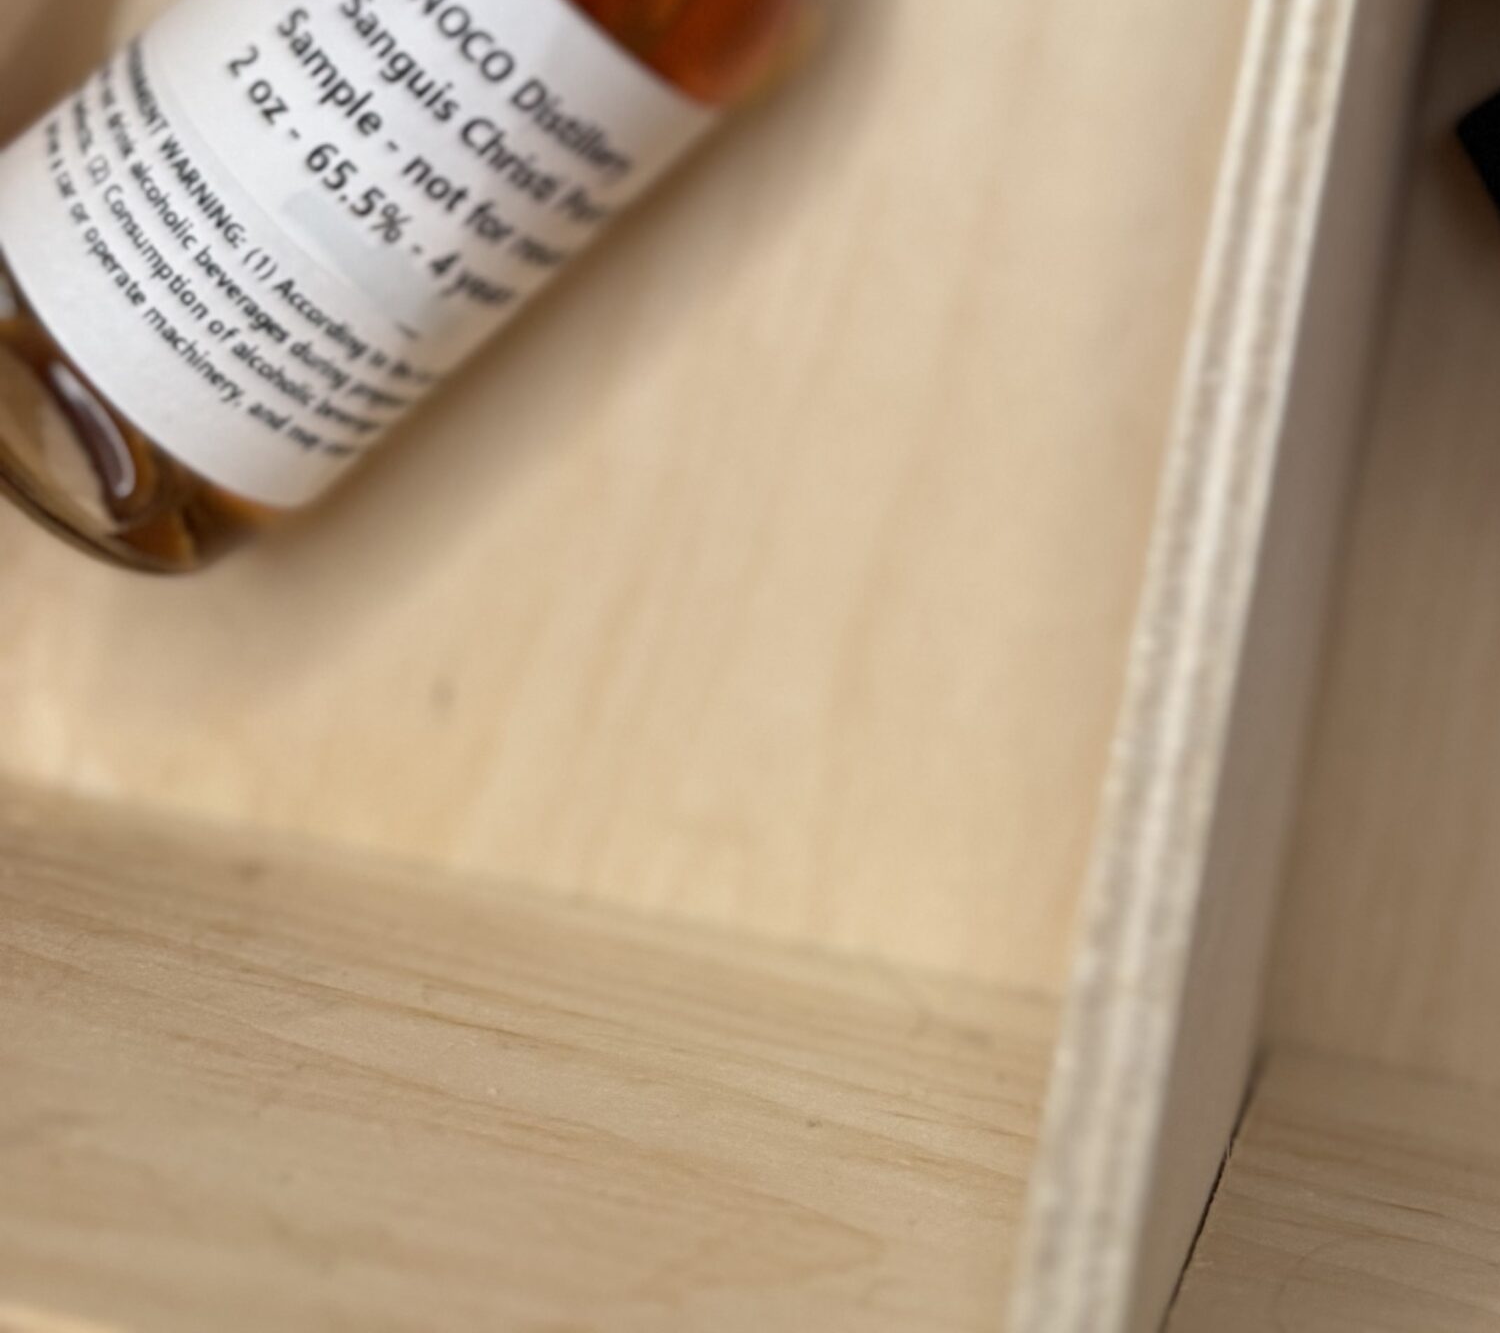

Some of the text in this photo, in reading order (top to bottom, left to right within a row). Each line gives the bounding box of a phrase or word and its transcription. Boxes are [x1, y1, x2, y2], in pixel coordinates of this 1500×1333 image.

[227, 46, 259, 77] 2
[248, 80, 288, 124] oz
[305, 144, 408, 244] 65.5%
[277, 8, 382, 136] Sample
[402, 156, 468, 212] not
[466, 201, 513, 243] for
[85, 228, 146, 306] operate
[104, 184, 209, 321] Consumption
[207, 320, 240, 341] of
[232, 343, 315, 405] alcoholic
[130, 162, 197, 249] alcoholic
[194, 247, 290, 344] beverages
[160, 137, 244, 248] WARNING:
[242, 248, 277, 281] (1)
[273, 279, 369, 359] According
